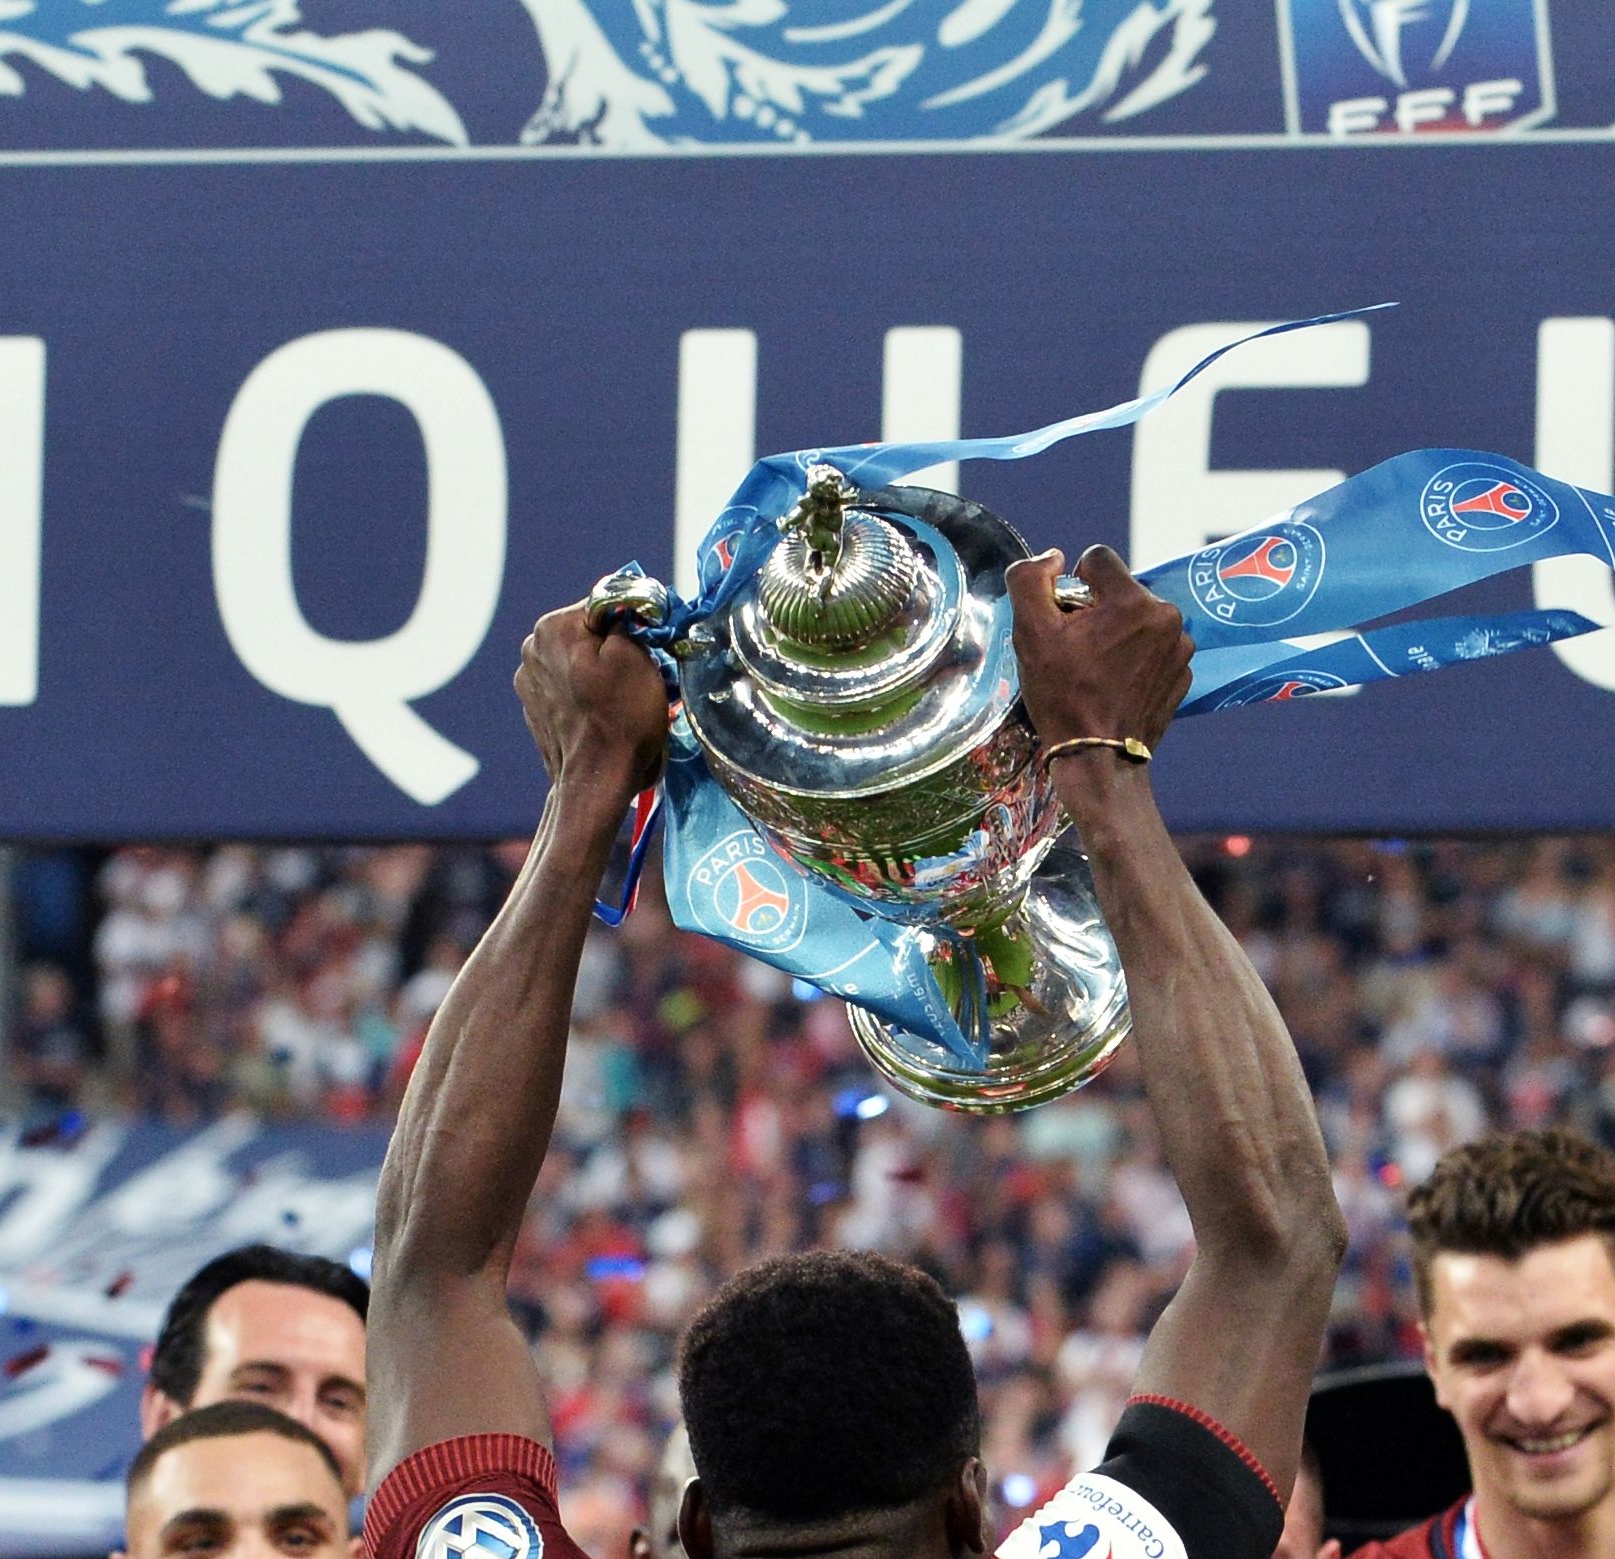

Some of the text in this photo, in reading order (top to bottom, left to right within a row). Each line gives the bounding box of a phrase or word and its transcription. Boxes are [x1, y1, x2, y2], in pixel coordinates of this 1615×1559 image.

[1327, 78, 1524, 139] FFF
[1427, 479, 1468, 542] PARIS
[1195, 547, 1237, 619] PARIS
[696, 836, 766, 886] PARIS
[1069, 1484, 1165, 1559] Carrefour
